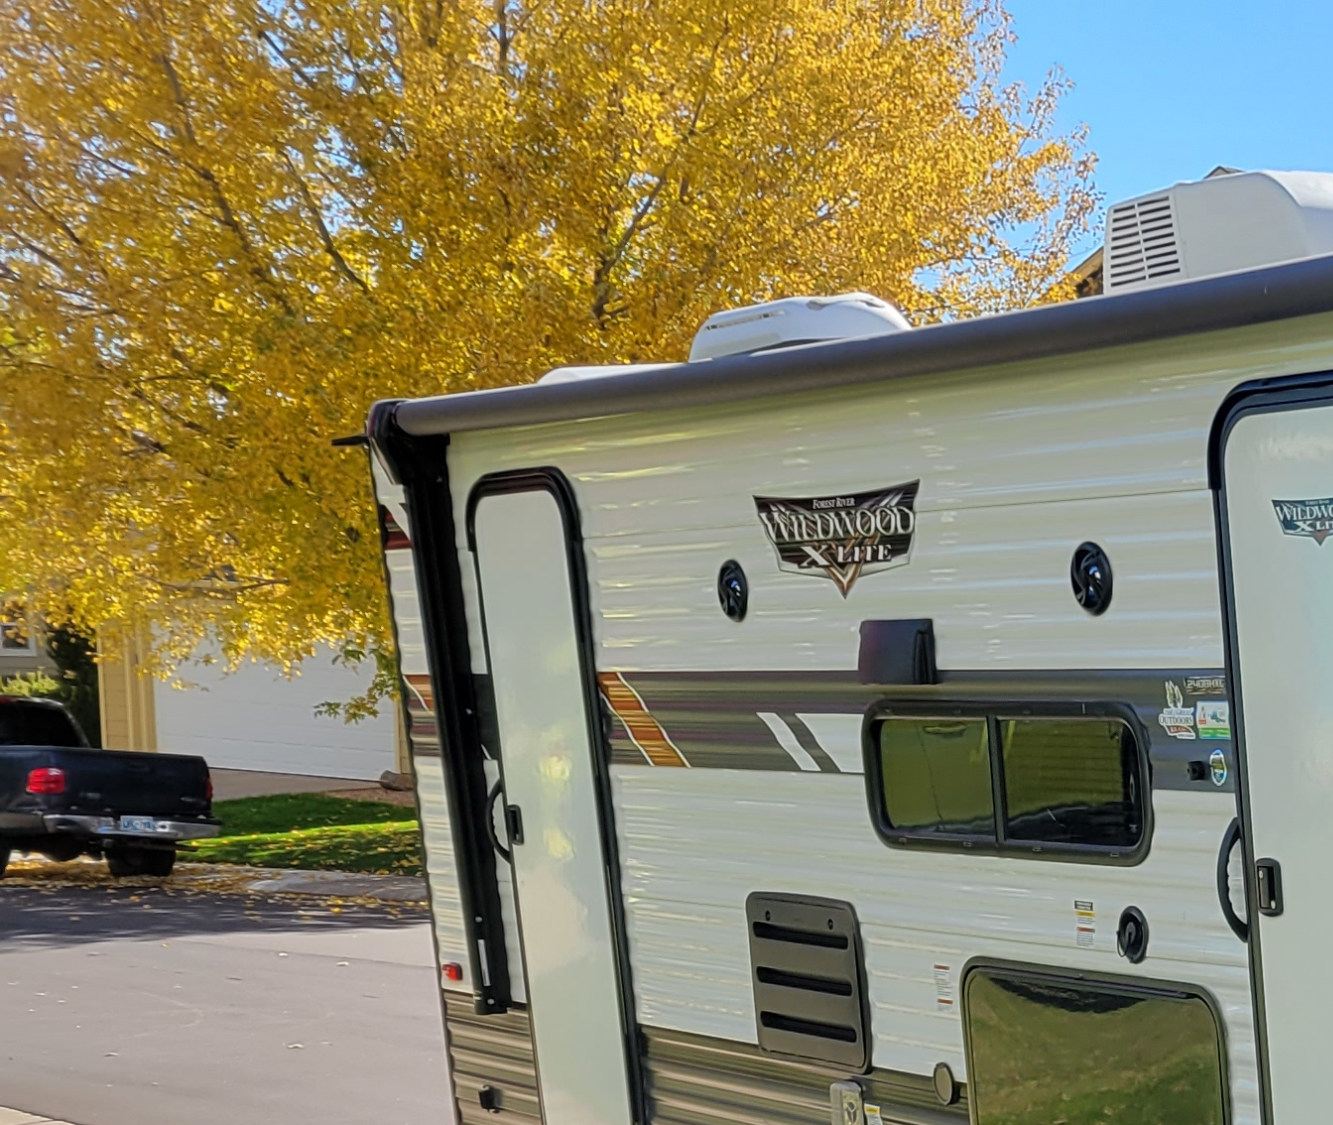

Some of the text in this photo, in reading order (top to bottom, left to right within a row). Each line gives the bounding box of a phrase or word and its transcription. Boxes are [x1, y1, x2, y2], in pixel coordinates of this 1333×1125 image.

[812, 497, 856, 510] FOREST RIVER
[759, 506, 914, 541] WILDWOOD
